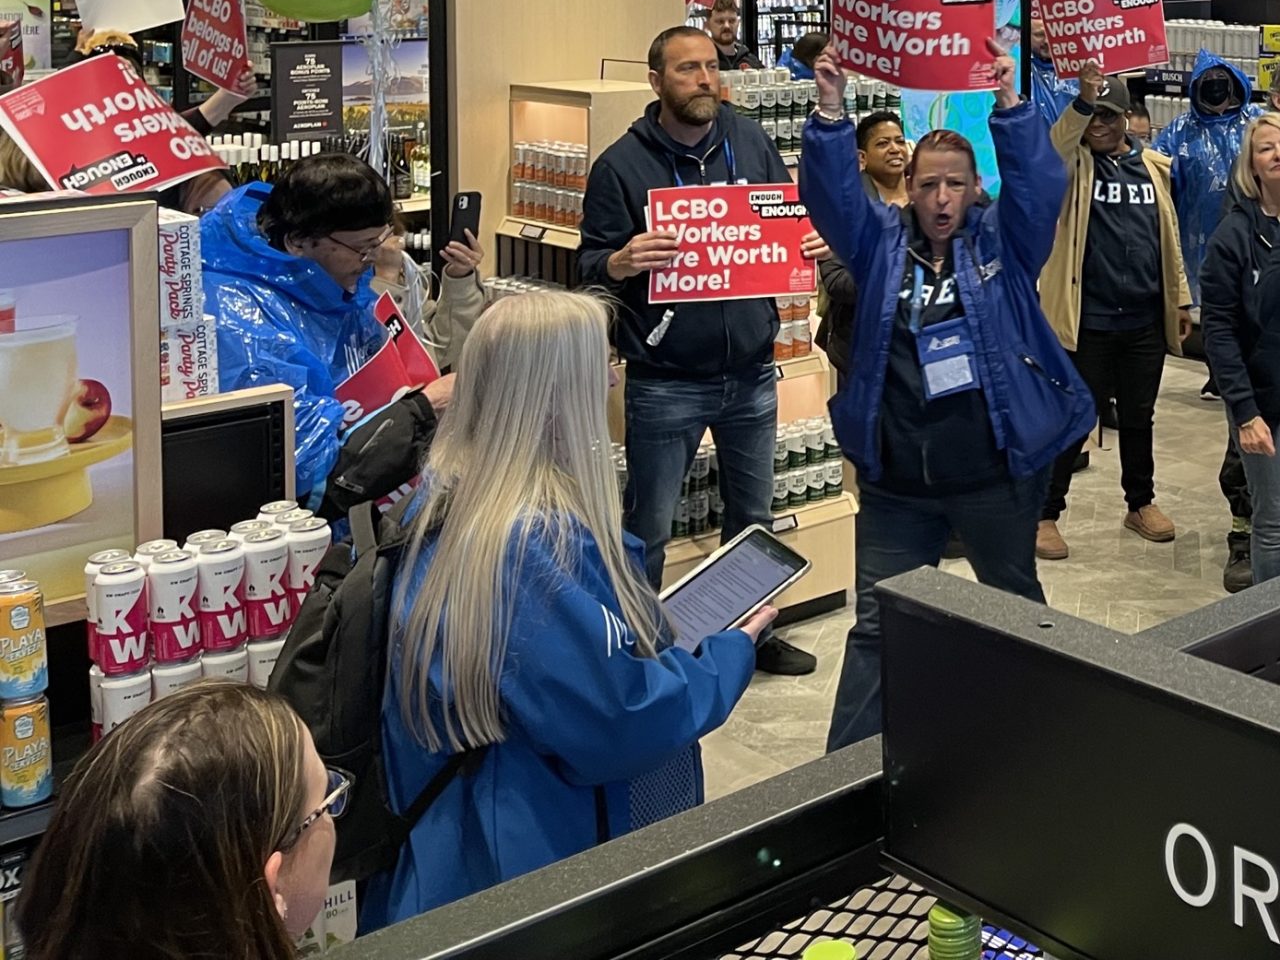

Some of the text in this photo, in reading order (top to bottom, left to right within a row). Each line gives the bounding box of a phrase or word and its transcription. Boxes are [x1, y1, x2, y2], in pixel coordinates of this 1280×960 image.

[187, 12, 244, 59] belongs to
[833, 13, 971, 57] are Worth
[1046, 15, 1125, 38] Workers
[833, 33, 901, 78] More!
[1052, 27, 1146, 56] are Worth
[183, 40, 232, 80] all of us!
[1162, 72, 1183, 83] BUSCH
[61, 86, 163, 133] Worth
[62, 153, 132, 189] ENOUGH
[115, 163, 156, 187] ENOUGH
[655, 198, 729, 222] LCBO
[750, 193, 782, 202] ENOUGH
[707, 242, 788, 267] Worth
[159, 231, 184, 320] Party Pack
[179, 225, 193, 319] COTTAGE SPRINGS
[655, 269, 731, 293] More!
[178, 331, 196, 377] Party
[196, 324, 207, 370] COTTAGE
[217, 610, 247, 639] W
[263, 598, 291, 626] W
[0, 628, 44, 658] PLAYA
[109, 631, 147, 664] W
[173, 621, 201, 649] W
[3, 738, 49, 767] PLAYA
[323, 890, 354, 909] HILL
